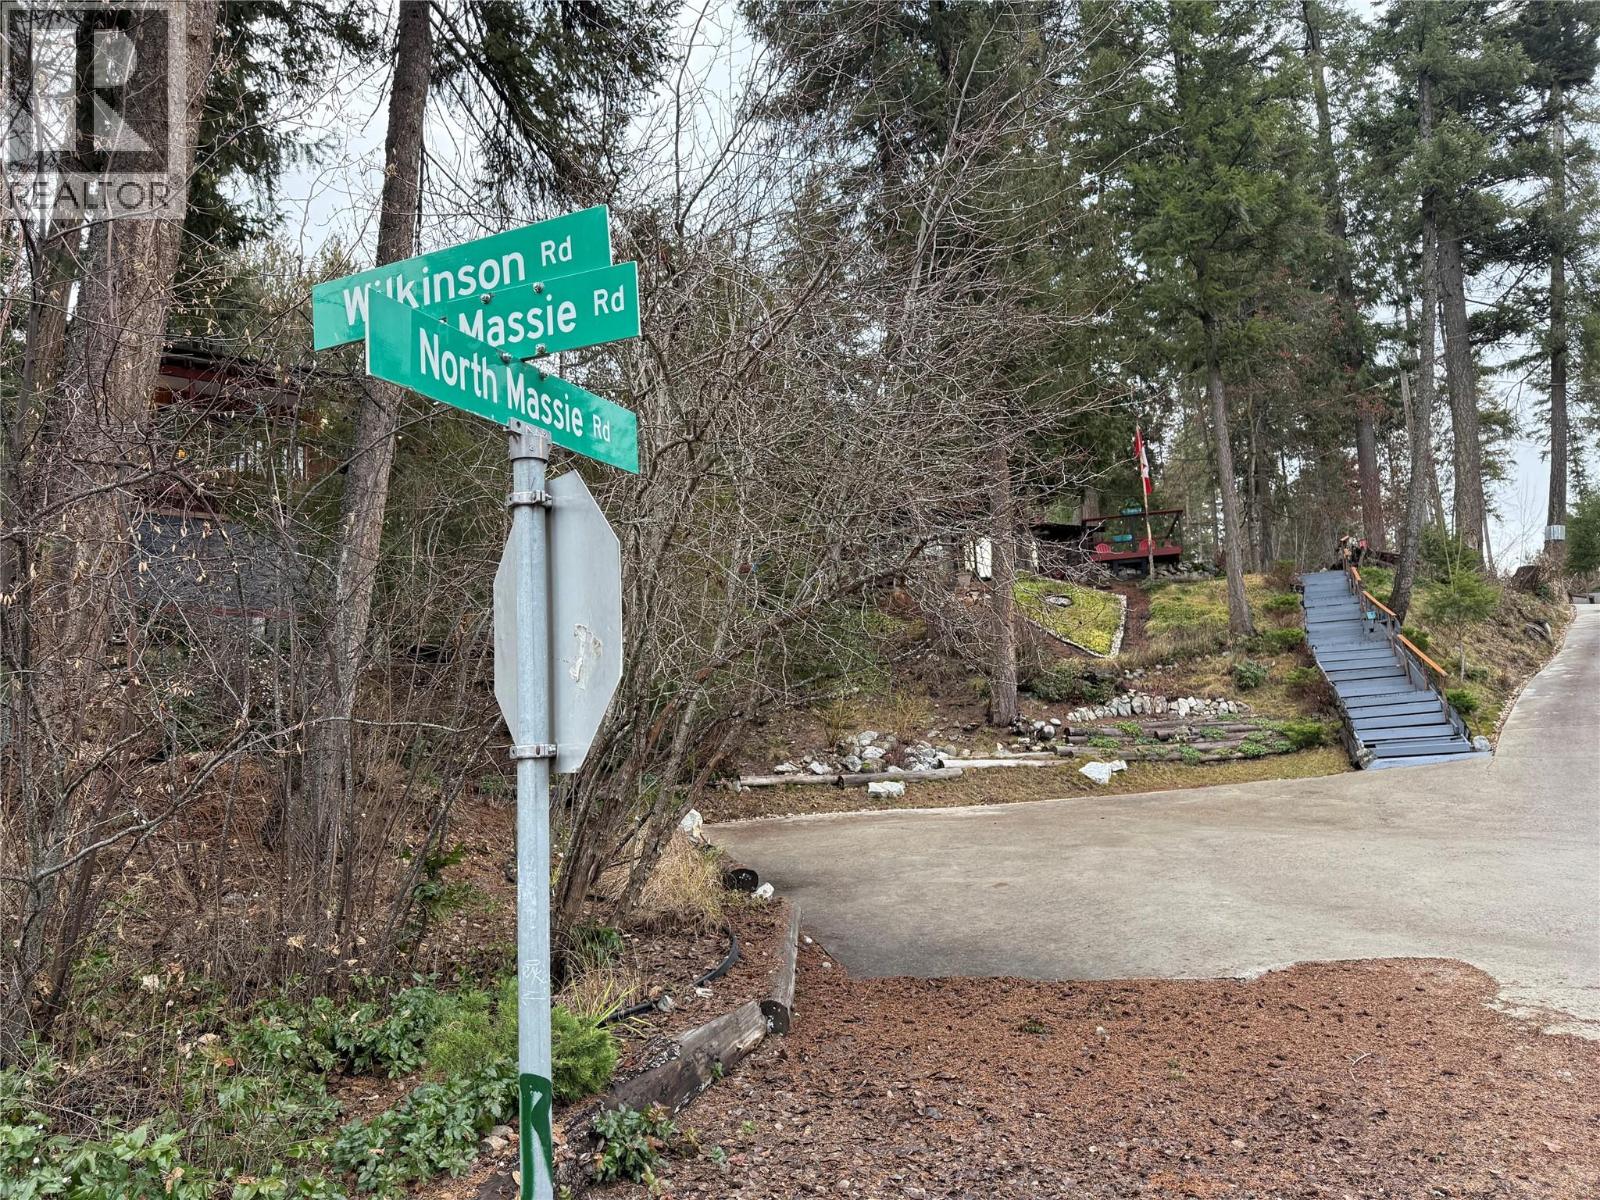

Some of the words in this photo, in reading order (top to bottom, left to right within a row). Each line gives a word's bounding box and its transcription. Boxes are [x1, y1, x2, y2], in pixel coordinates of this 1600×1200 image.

[343, 252, 525, 325] Wlkinson
[541, 235, 573, 267] Rd
[458, 294, 577, 347] Massie
[593, 284, 625, 316] Rd
[419, 327, 498, 404] North
[506, 367, 583, 437] Massie
[592, 414, 611, 442] Rd
